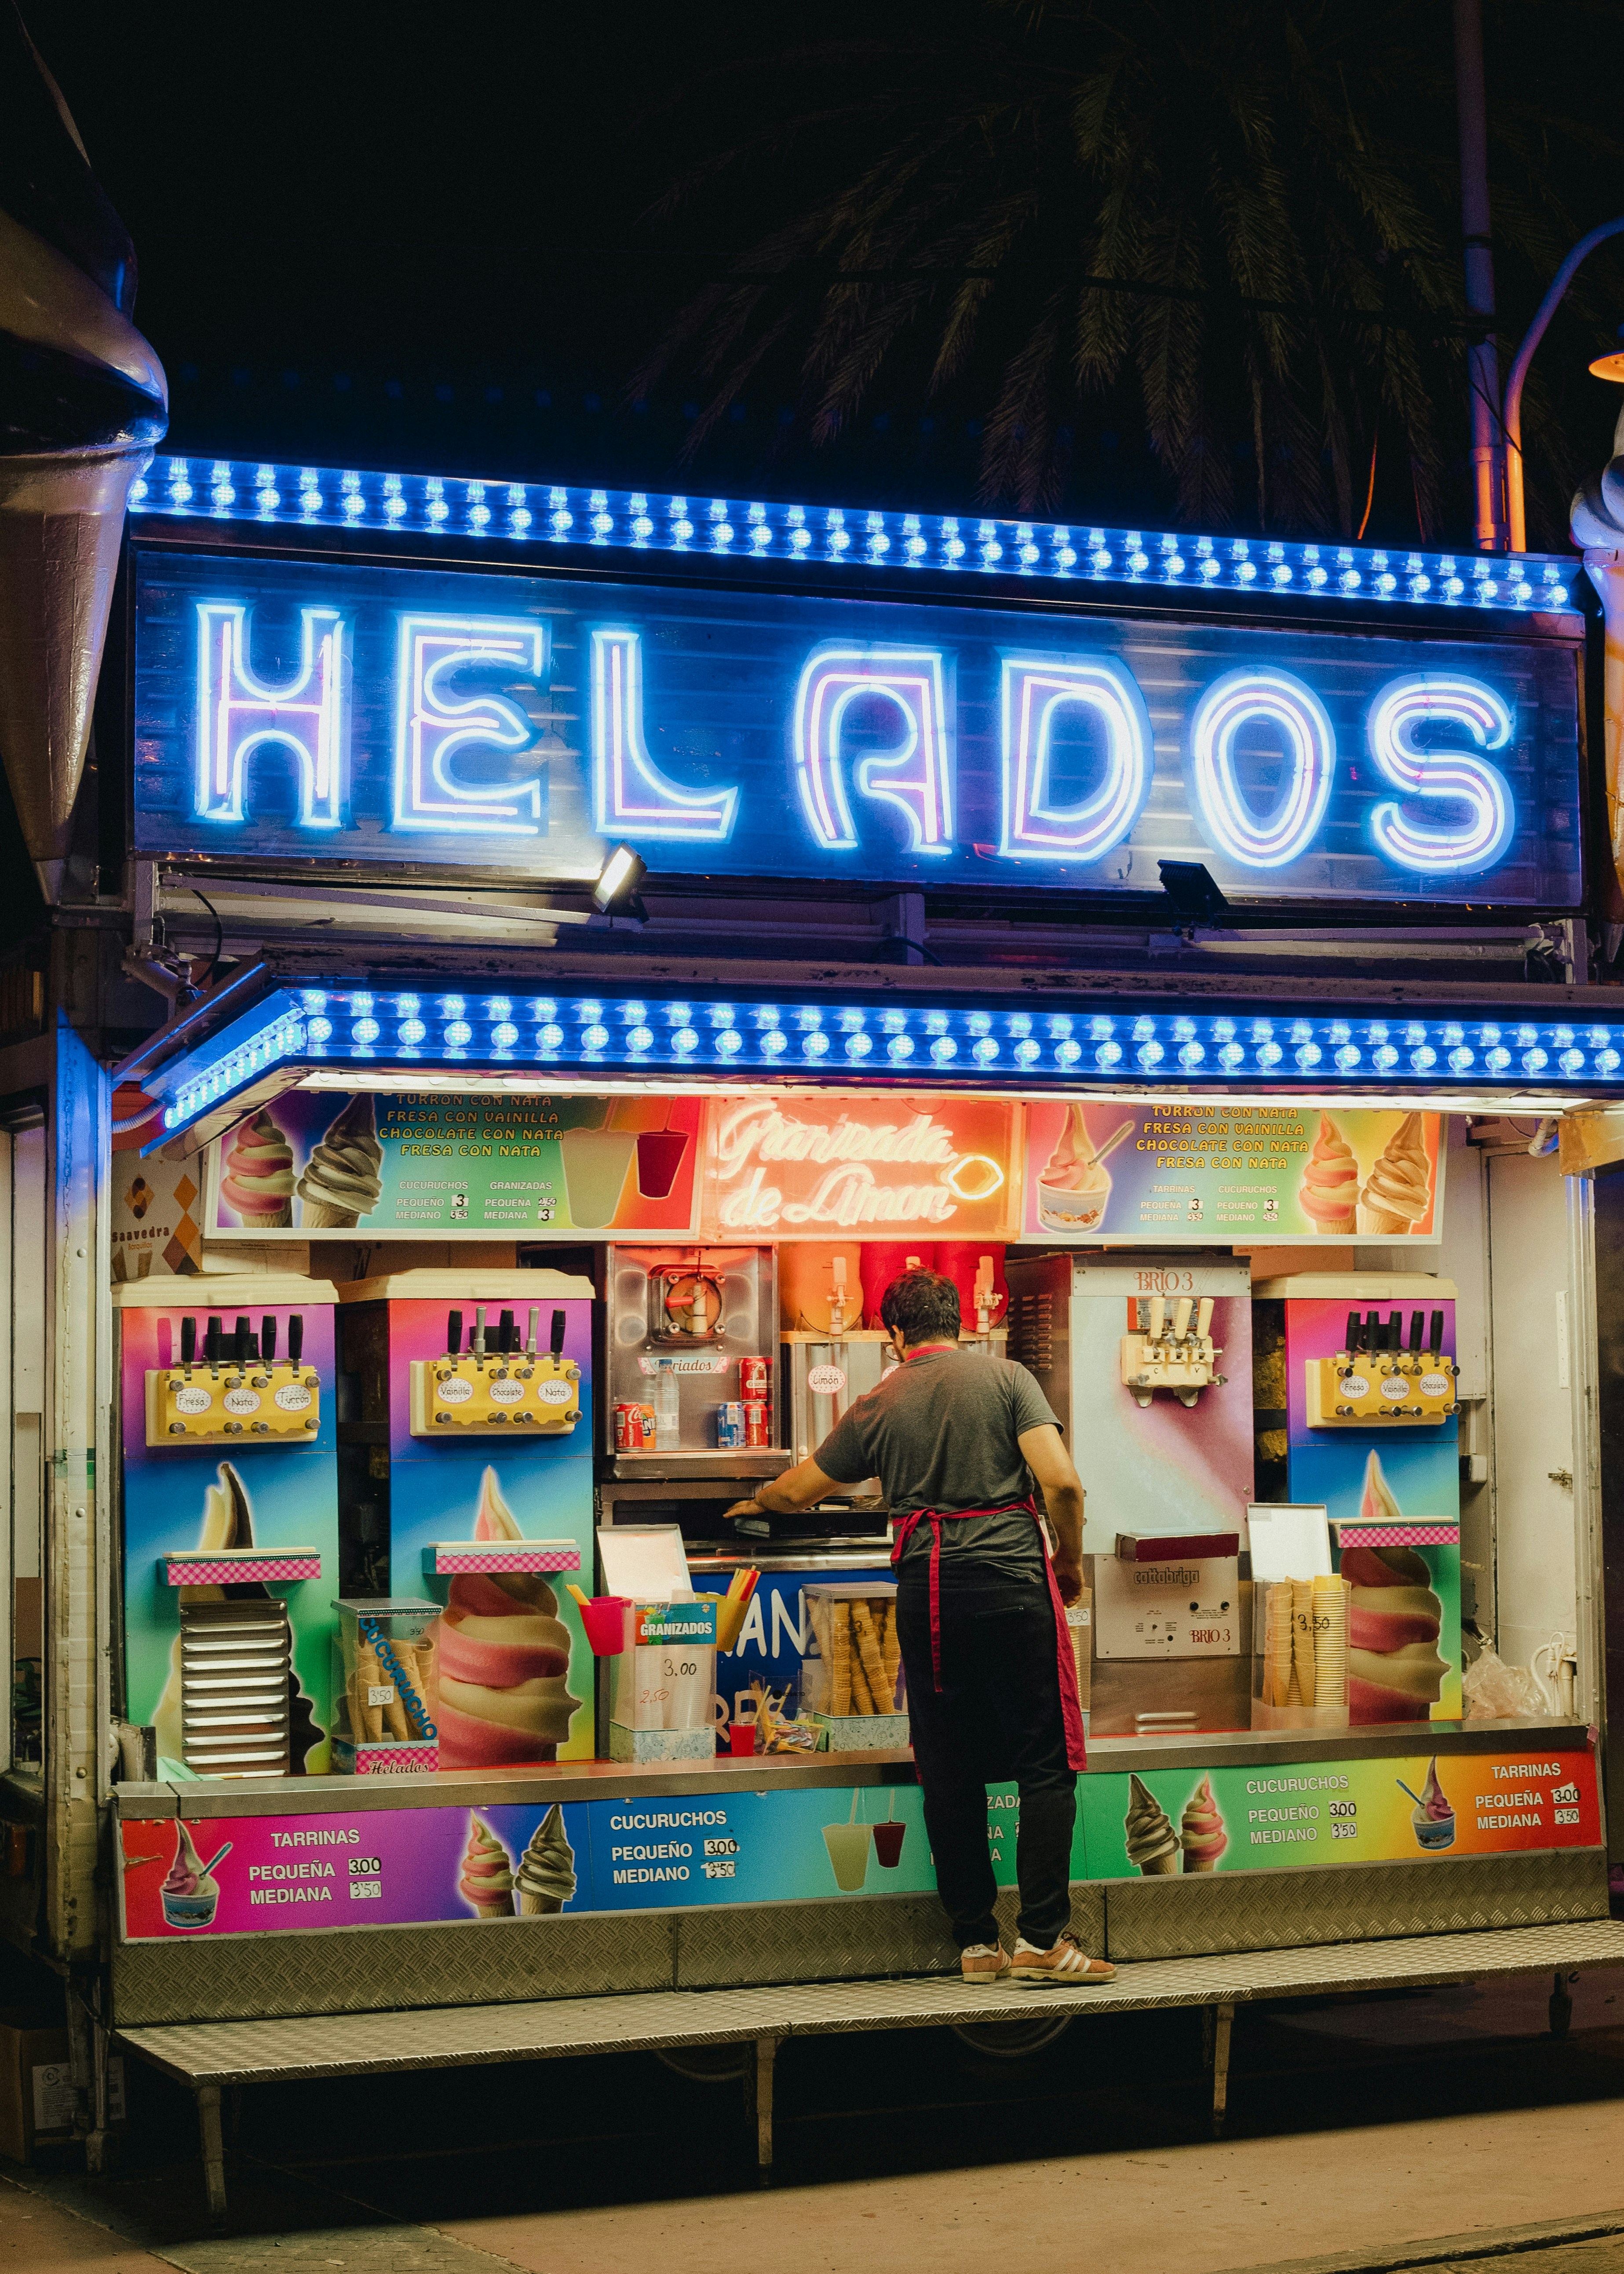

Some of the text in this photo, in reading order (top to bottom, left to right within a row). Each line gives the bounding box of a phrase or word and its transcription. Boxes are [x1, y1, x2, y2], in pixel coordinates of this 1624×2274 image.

[193, 599, 1516, 876] HELADOS
[470, 1095, 502, 1106] CON
[510, 1096, 552, 1106] NATA
[387, 1111, 559, 1123] FRESA CON VAINILLA
[1221, 1107, 1252, 1118] CON
[1259, 1108, 1298, 1119] NATA
[379, 1128, 564, 1141] CHOCOLATE CON NATA
[1143, 1122, 1304, 1136] FRESA CON VAINILLA
[711, 1102, 958, 1179] Granizada
[1135, 1139, 1309, 1152] CHOCOLATE CON NATA
[401, 1144, 541, 1157] FRESA CON NATA
[1156, 1156, 1288, 1170] FRESA CON NATA
[399, 1181, 468, 1189] CUCURUCHOS
[489, 1181, 553, 1190] GRANIZADAS
[396, 1194, 465, 1207] PEQUEÑO 3
[484, 1197, 532, 1207] PEQUEÑA
[723, 1167, 782, 1227] de
[1140, 1199, 1199, 1210] PEQUEÑA 3
[1217, 1199, 1274, 1211] PEQUEÑO 3
[396, 1211, 441, 1219] MEDIANO
[484, 1208, 550, 1221] MEDIANA 3
[1133, 1271, 1179, 1293] BRIO
[1182, 1272, 1193, 1291] 3
[813, 1375, 839, 1385] Limón
[441, 1386, 470, 1396] Vainilla
[493, 1388, 522, 1396] Chocolate
[545, 1388, 565, 1397] Nata
[1383, 1385, 1407, 1393] Vainilla
[179, 1394, 205, 1406] Fresa
[231, 1398, 253, 1407] Nata
[278, 1391, 309, 1404] Turrón
[1134, 1567, 1200, 1587] cattabriga
[640, 1622, 712, 1636] GRANIZADOS
[1189, 1629, 1230, 1644] BRIO 3
[359, 1618, 437, 1740] CUCURUCHO
[368, 1759, 429, 1774] Helados
[1491, 1762, 1561, 1779] TARRINAS
[1246, 1774, 1349, 1795] CUCURUCHOS
[1475, 1789, 1544, 1809] PEQUEÑA
[1248, 1803, 1320, 1823] PEQUEÑO
[610, 1810, 727, 1831] CUCURUCHOS
[1477, 1813, 1542, 1830] MEDIANA
[270, 1828, 361, 1847] TARRINAS
[1250, 1827, 1317, 1845] MEDIANO
[611, 1840, 693, 1861] PEQUEÑO
[249, 1859, 336, 1881] PEQUEÑA
[613, 1866, 690, 1884] MEDIANO
[250, 1886, 333, 1905] MEDIANA
